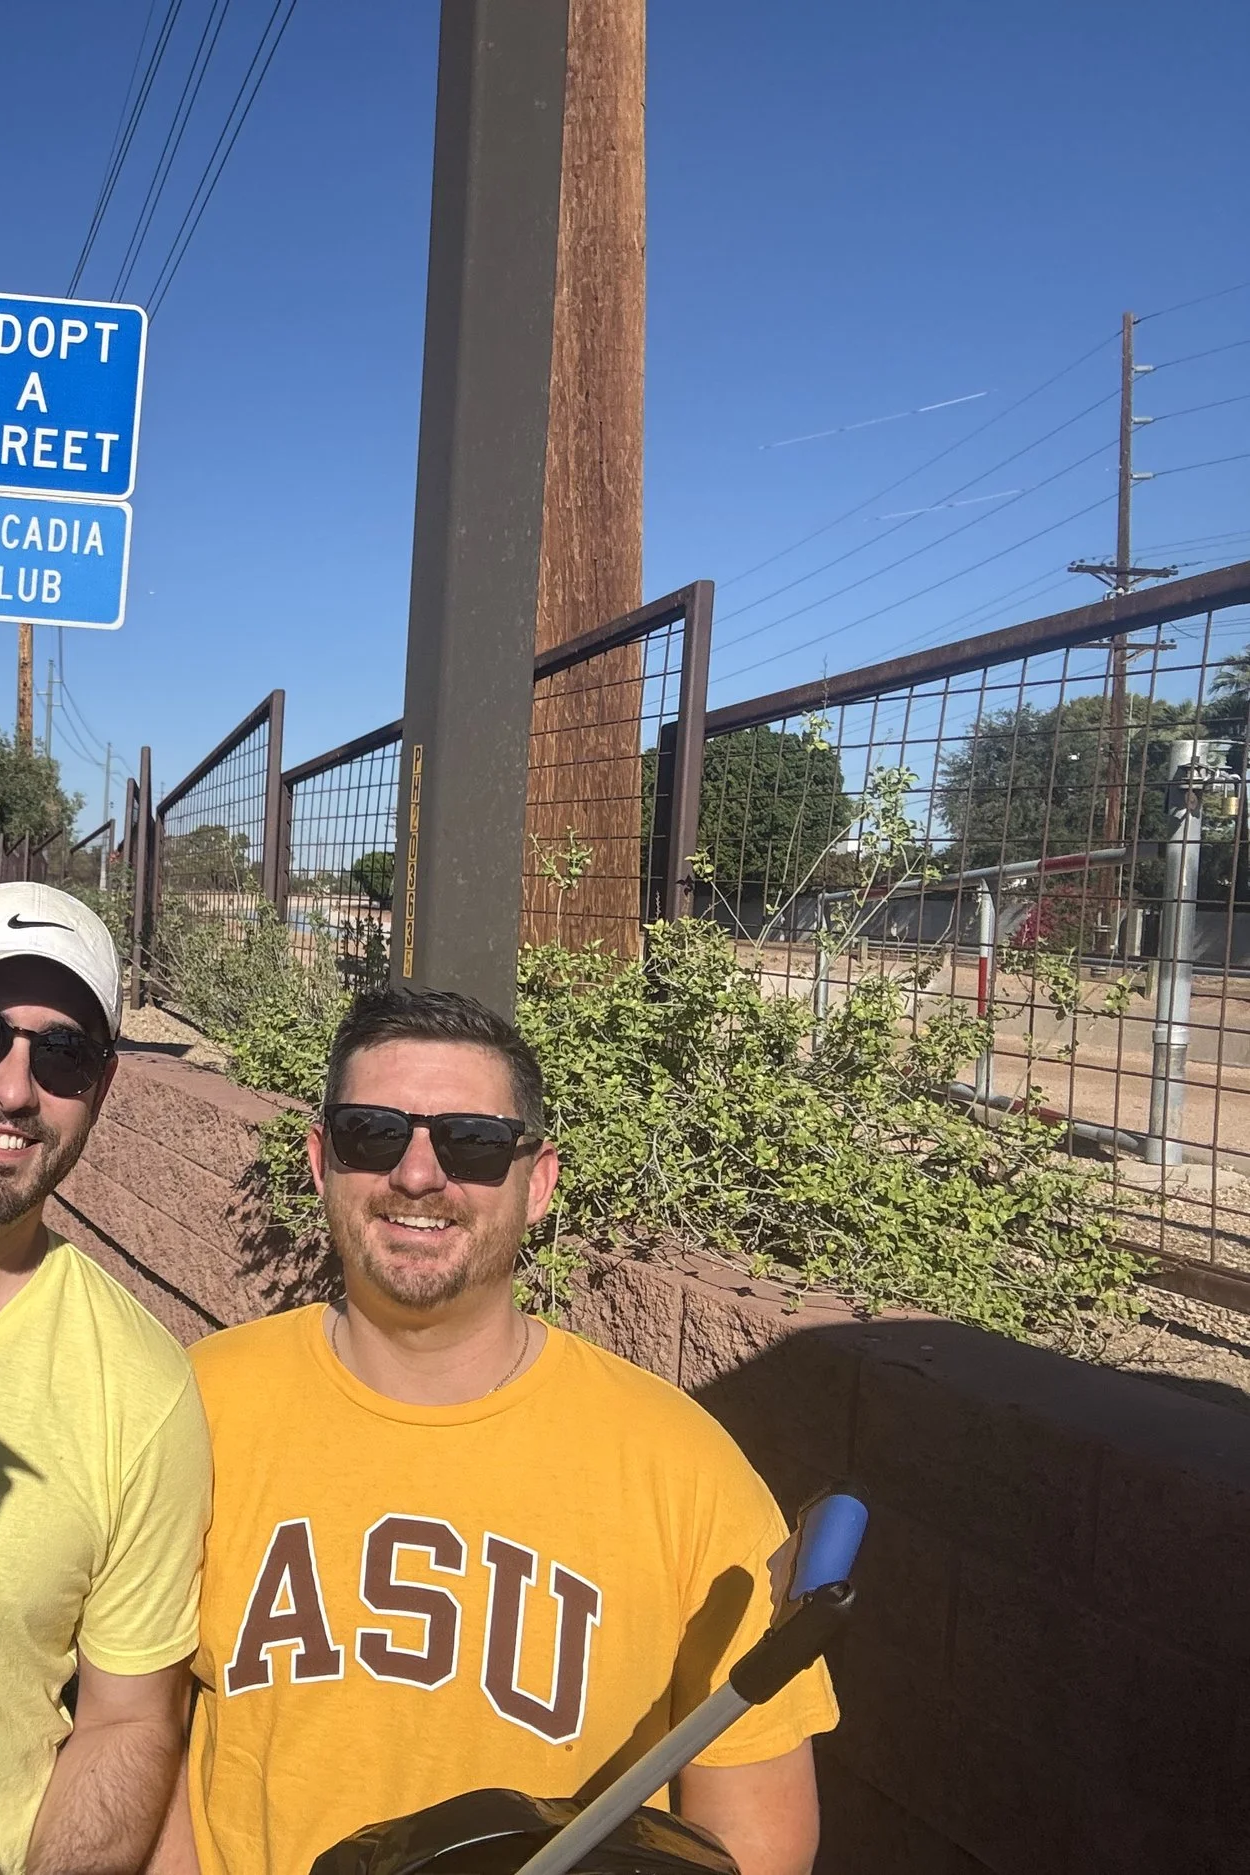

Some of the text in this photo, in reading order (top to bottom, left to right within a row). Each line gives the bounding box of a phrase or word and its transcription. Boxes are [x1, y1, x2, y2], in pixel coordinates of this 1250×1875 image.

[16, 371, 48, 413] A
[404, 745, 422, 977] PH203635
[224, 1512, 602, 1746] ASU
